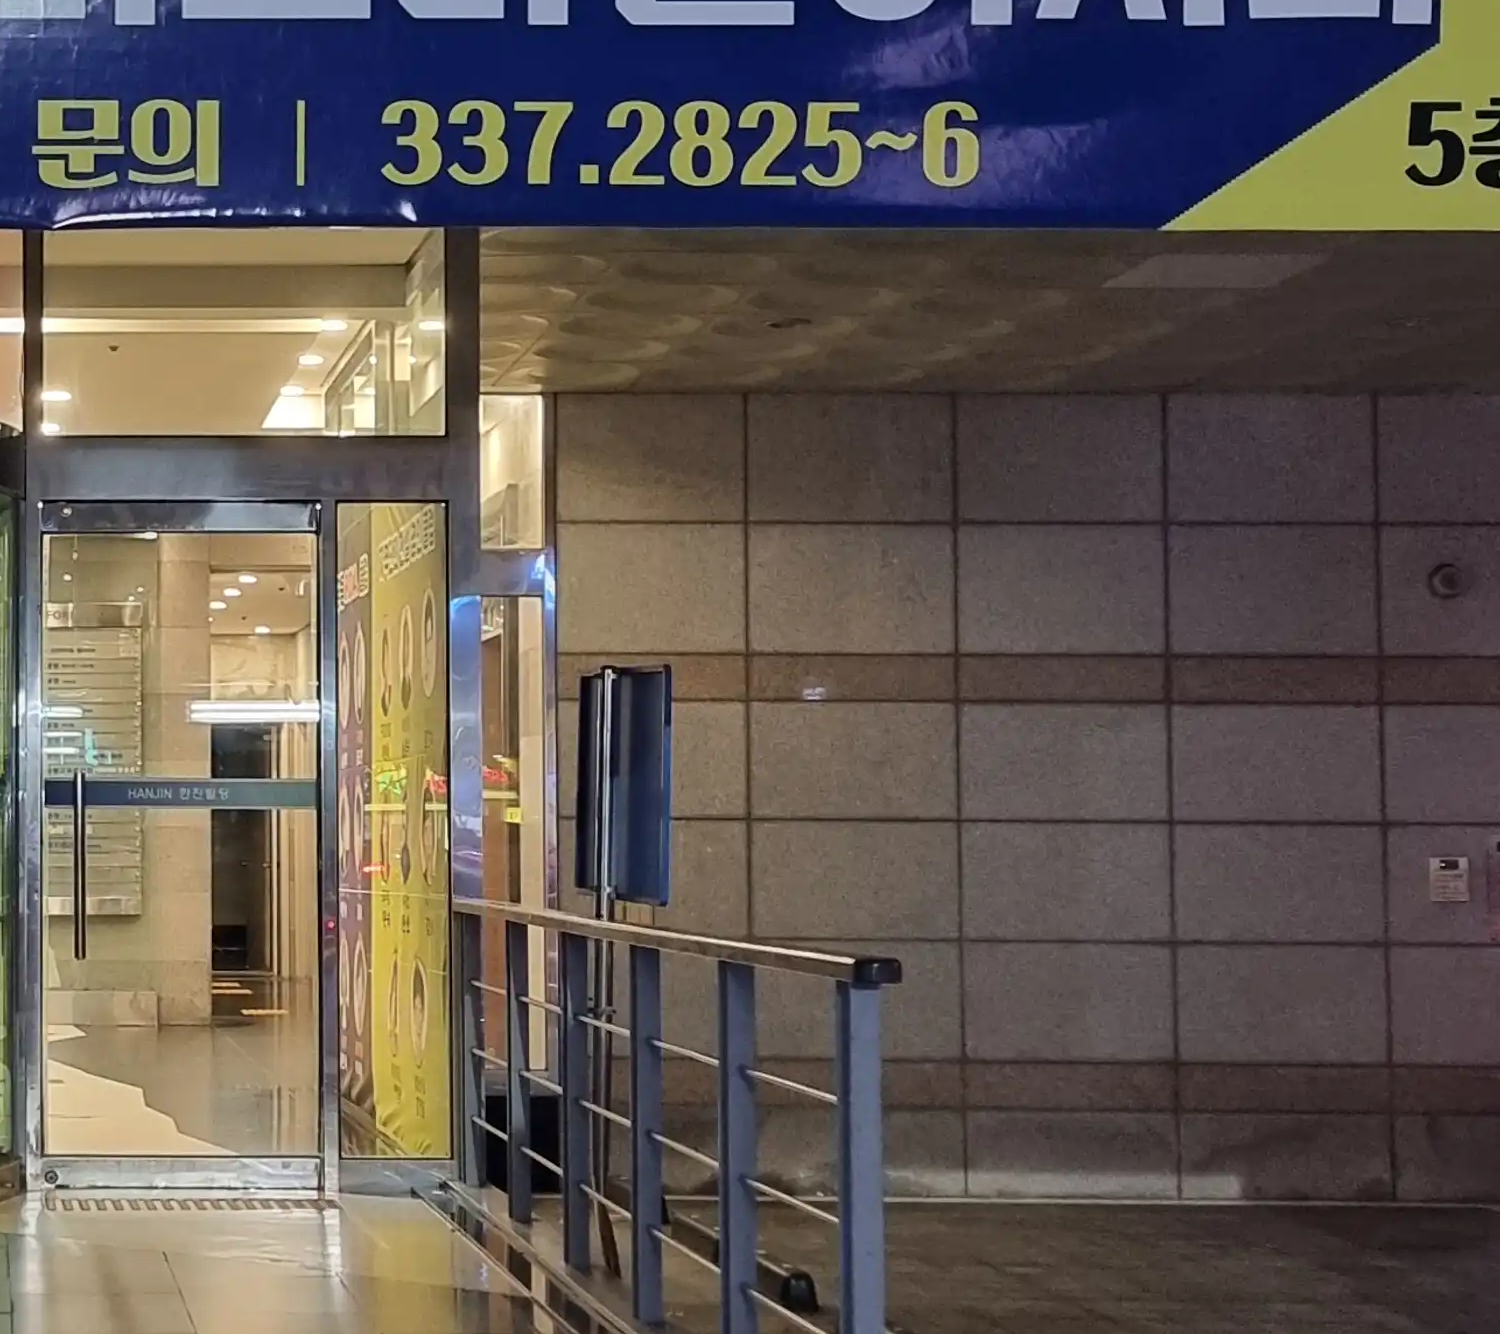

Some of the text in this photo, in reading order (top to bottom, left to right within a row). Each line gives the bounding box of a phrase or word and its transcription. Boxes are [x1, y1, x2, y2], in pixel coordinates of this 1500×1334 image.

[31, 99, 980, 188] 문의 337.2825~6
[128, 787, 173, 799] HANJIN
